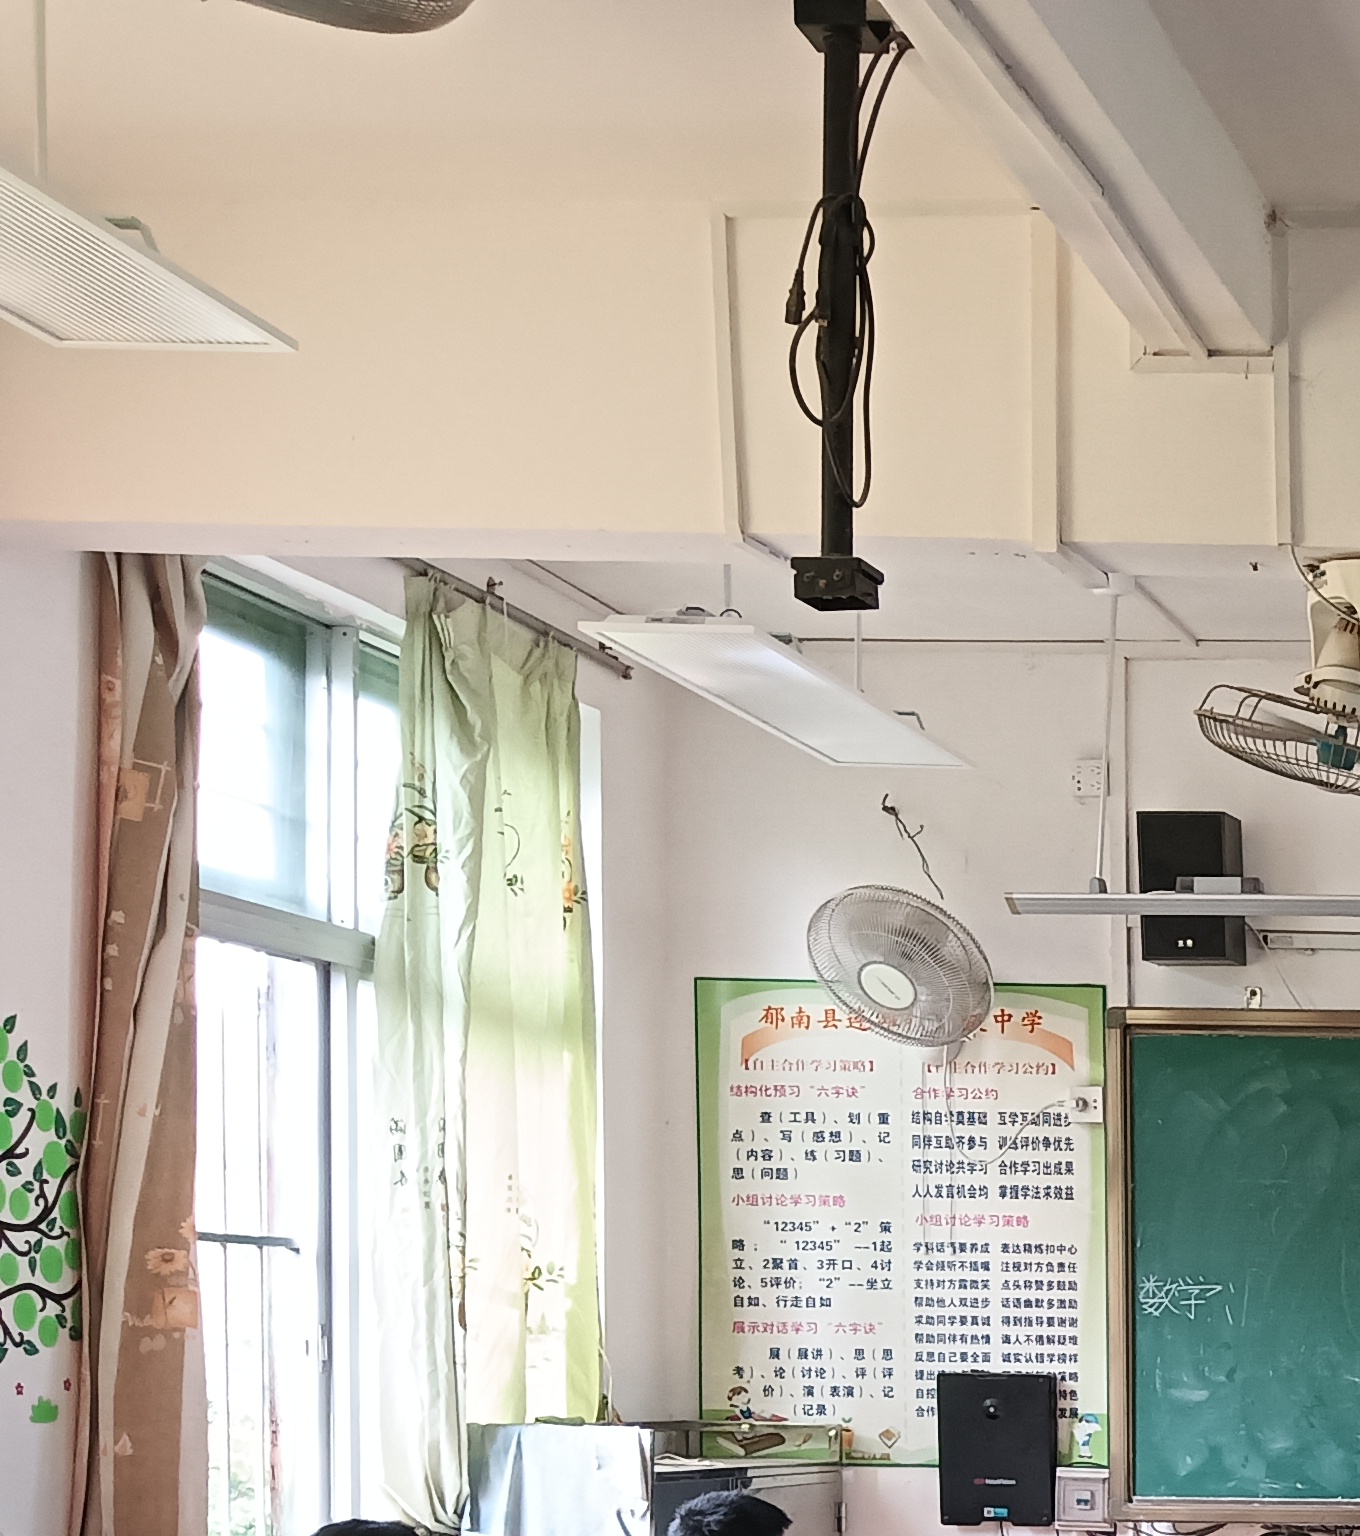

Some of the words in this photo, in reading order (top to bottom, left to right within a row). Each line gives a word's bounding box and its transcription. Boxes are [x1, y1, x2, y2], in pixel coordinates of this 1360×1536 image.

[730, 1084, 801, 1098] 结构化预习
[912, 1087, 999, 1100] 合作学习公约
[998, 1160, 1075, 1176] 合作学习出成果
[731, 1193, 847, 1208] 小组讨论学习策略
[915, 1214, 1030, 1228] 小组讨论学习策略
[732, 1321, 818, 1335] 展示对话学习
